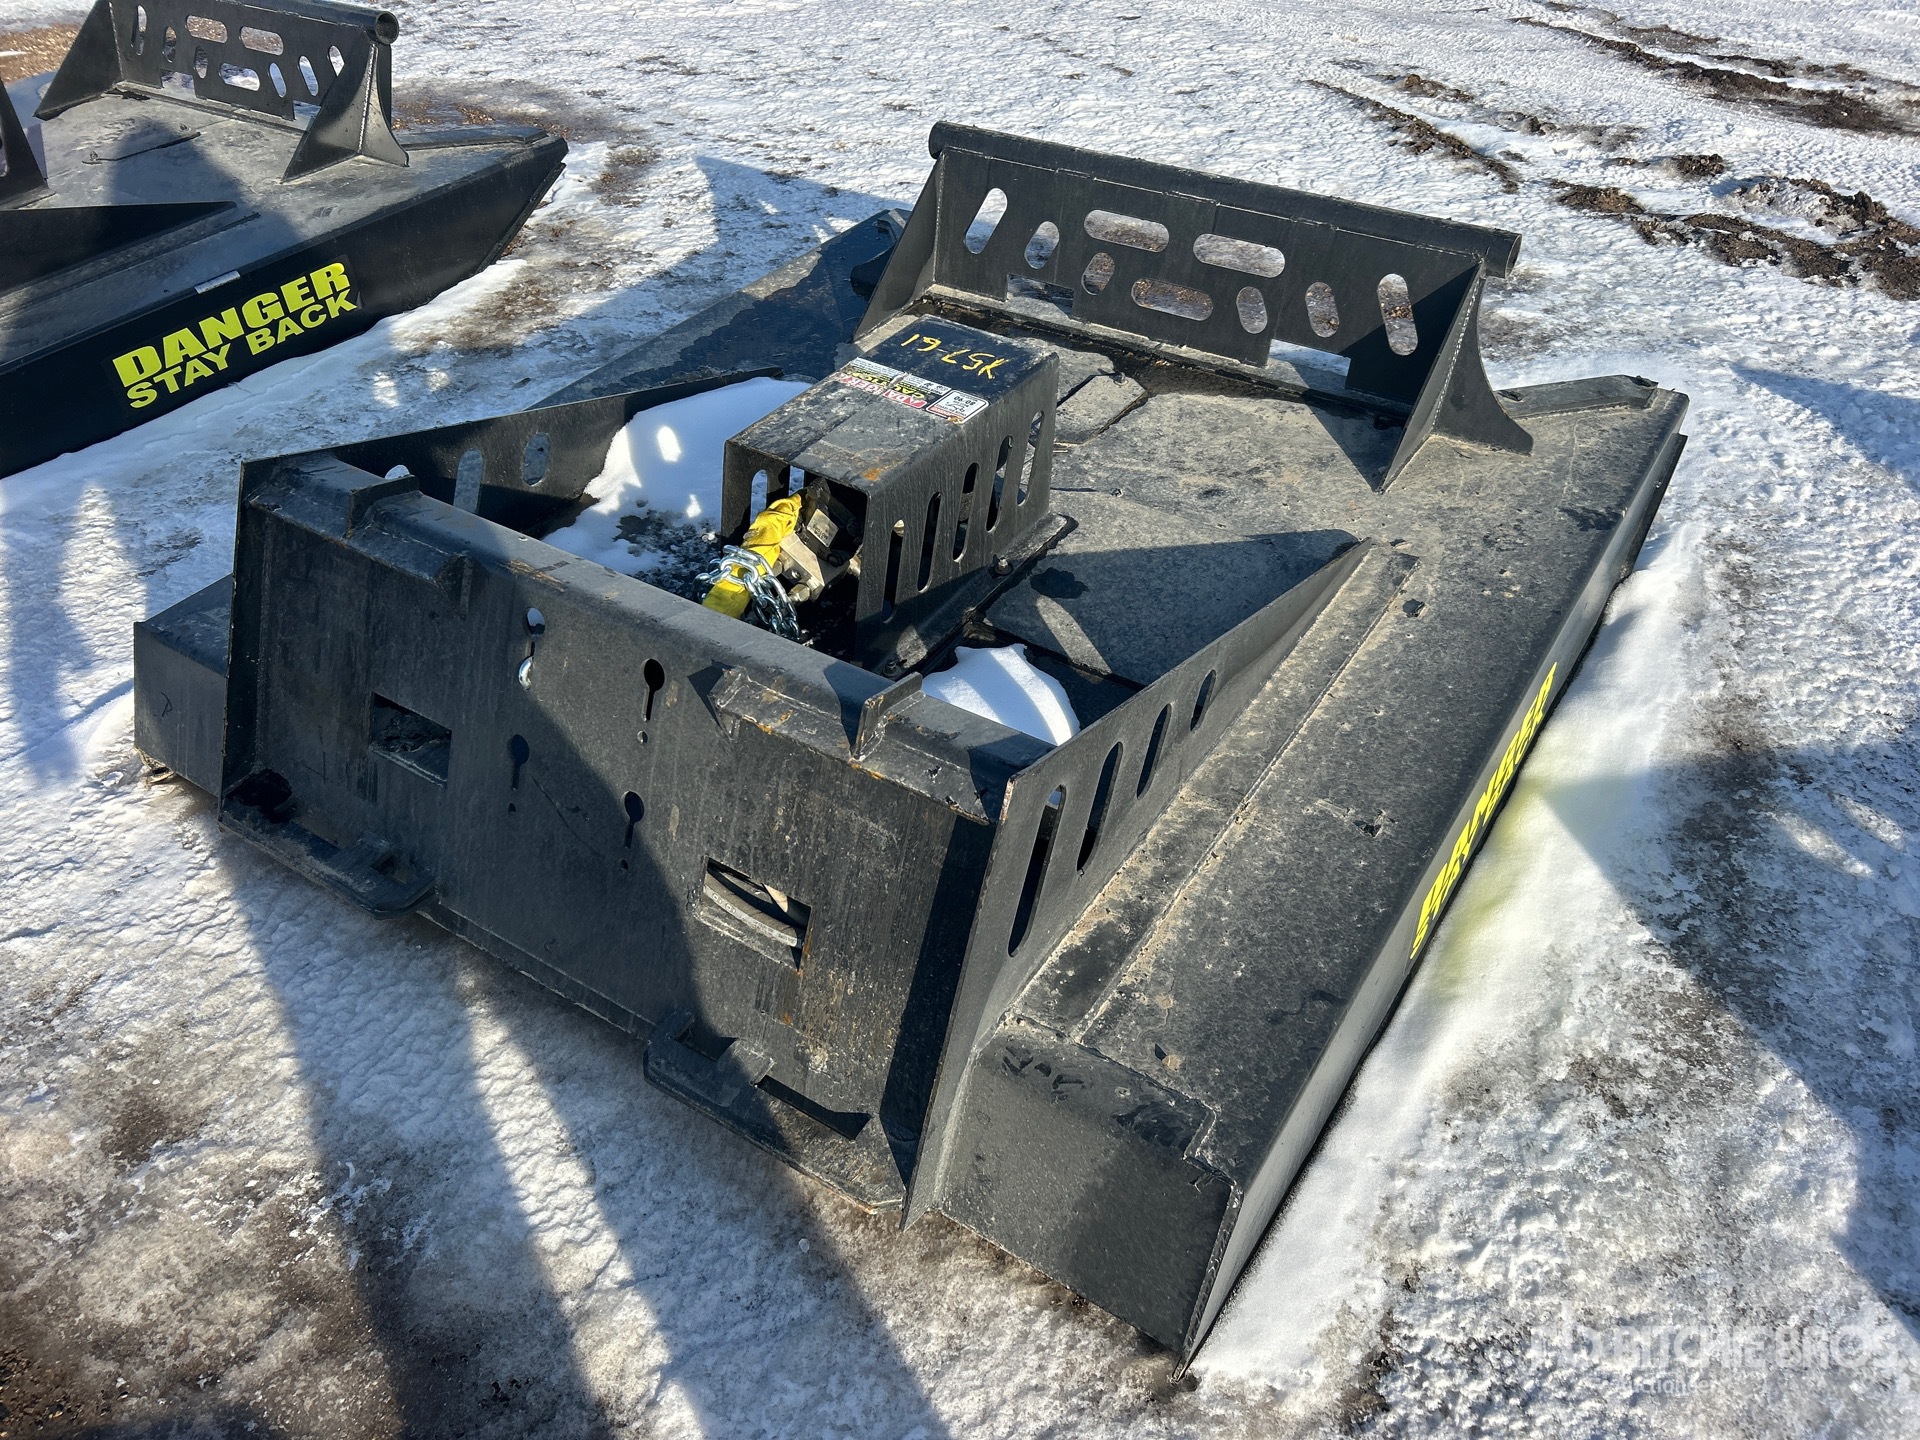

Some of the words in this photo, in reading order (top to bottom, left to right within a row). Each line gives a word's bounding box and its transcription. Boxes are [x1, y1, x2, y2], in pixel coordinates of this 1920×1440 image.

[113, 263, 351, 387] DANGER
[128, 345, 230, 409] STAY
[246, 290, 357, 356] BACK
[1415, 661, 1558, 936] DANGER
